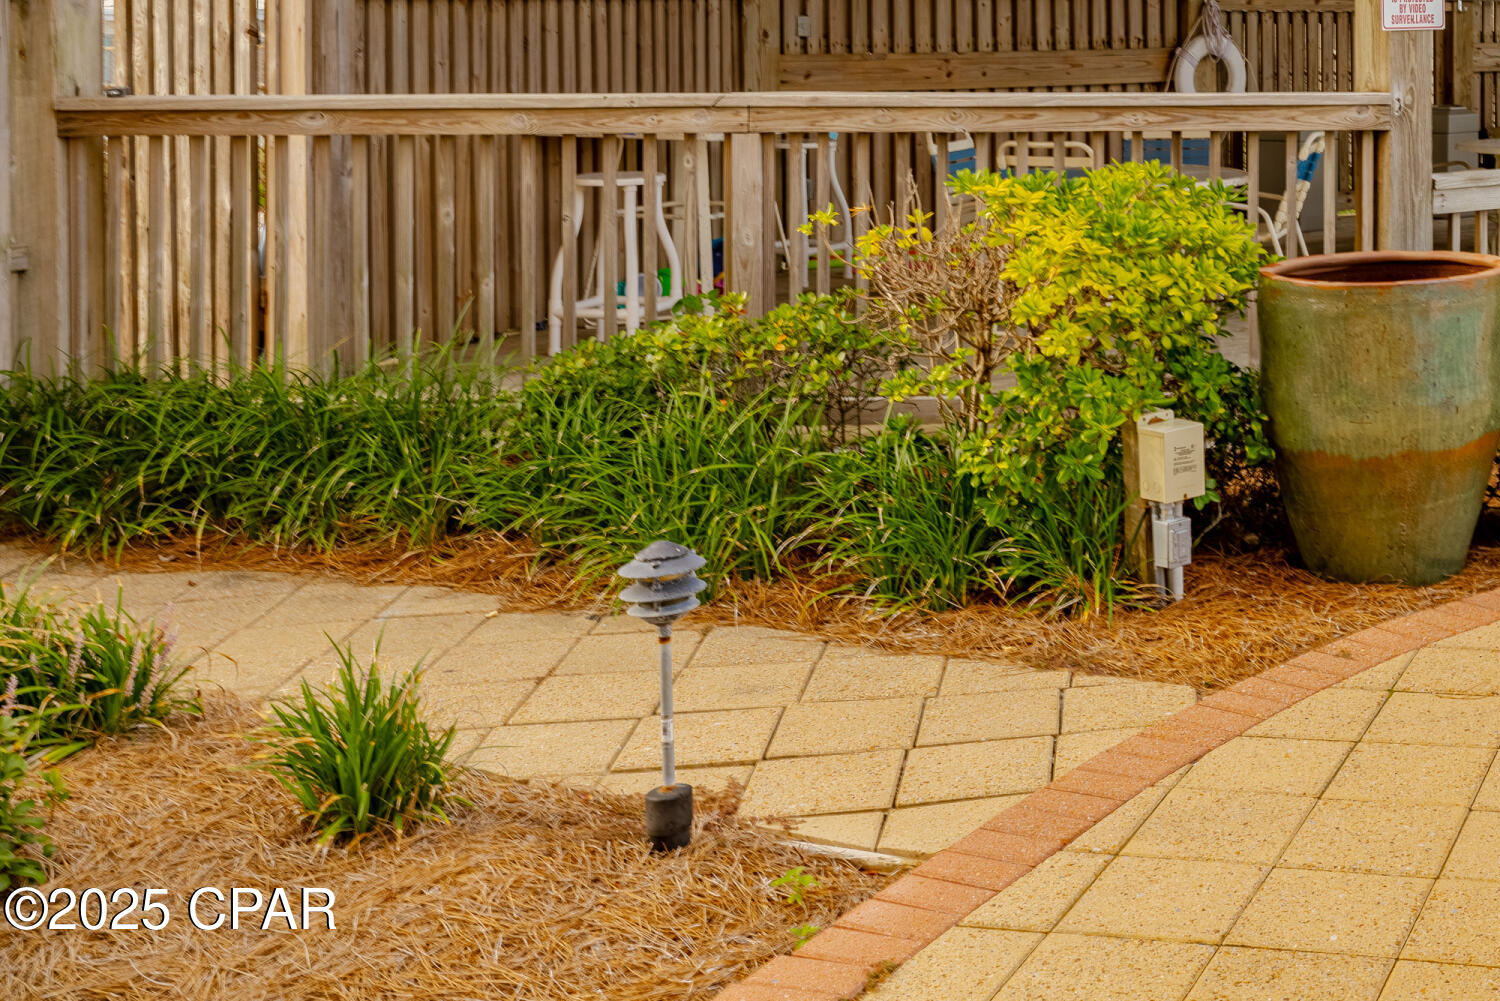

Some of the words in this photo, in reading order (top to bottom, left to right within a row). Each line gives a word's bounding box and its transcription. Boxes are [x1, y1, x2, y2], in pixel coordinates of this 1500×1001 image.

[1399, 4, 1406, 13] BY
[1409, 4, 1426, 13] VIDEO
[1391, 14, 1435, 24] SURVEILLANCE
